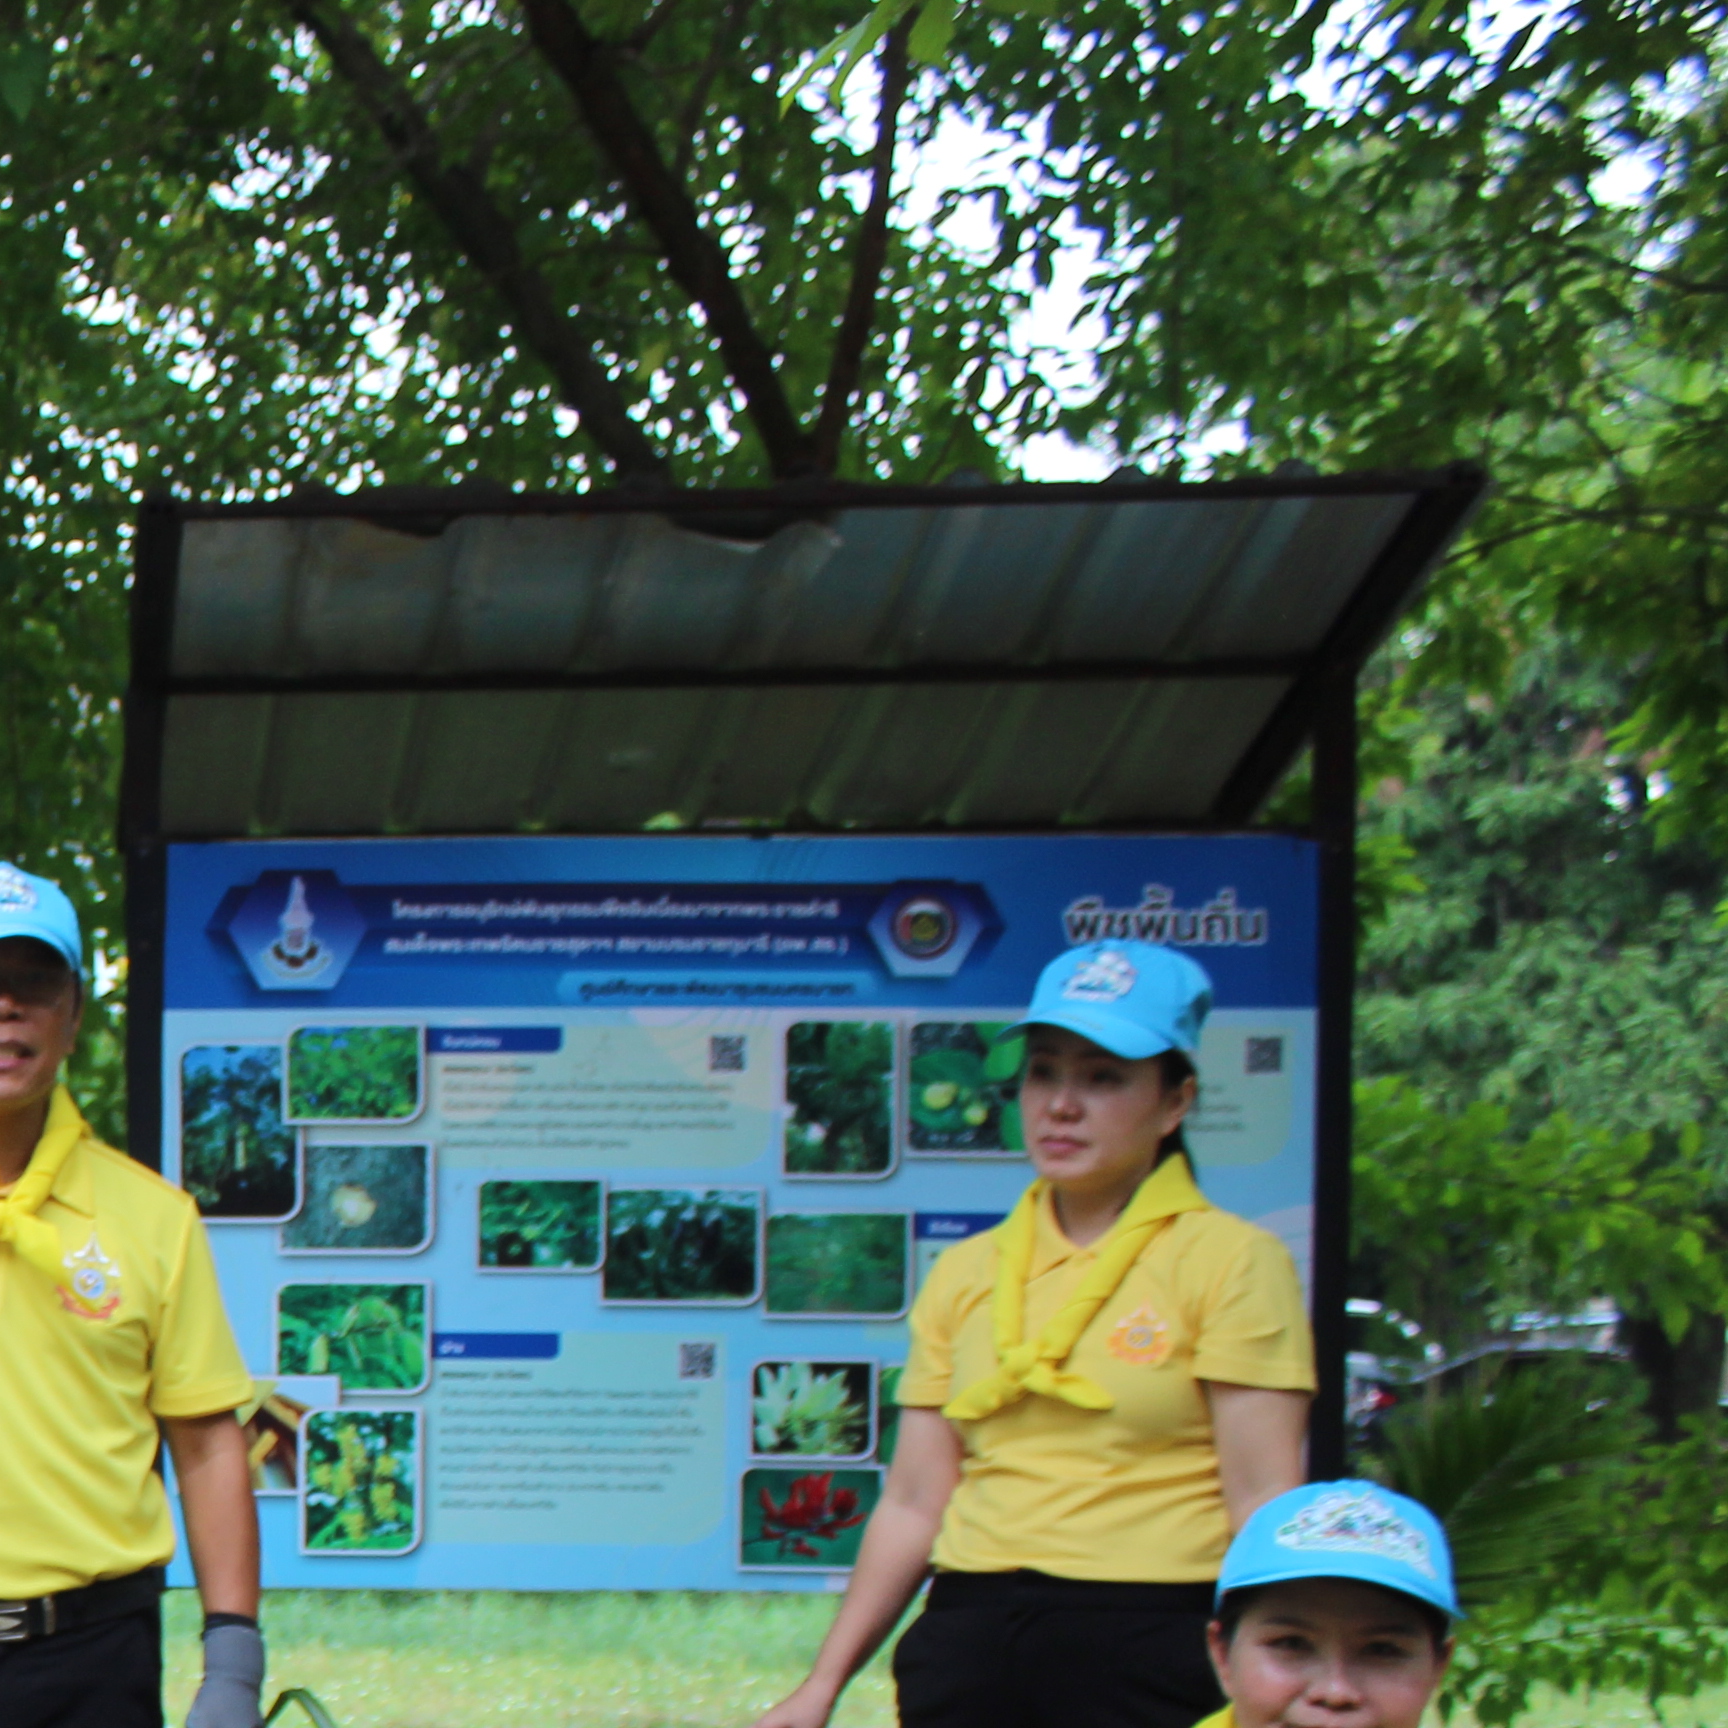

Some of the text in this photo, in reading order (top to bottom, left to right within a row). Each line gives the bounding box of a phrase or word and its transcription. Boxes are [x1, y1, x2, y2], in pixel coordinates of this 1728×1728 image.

[1065, 886, 1265, 942] พืชพื้นถิ่น
